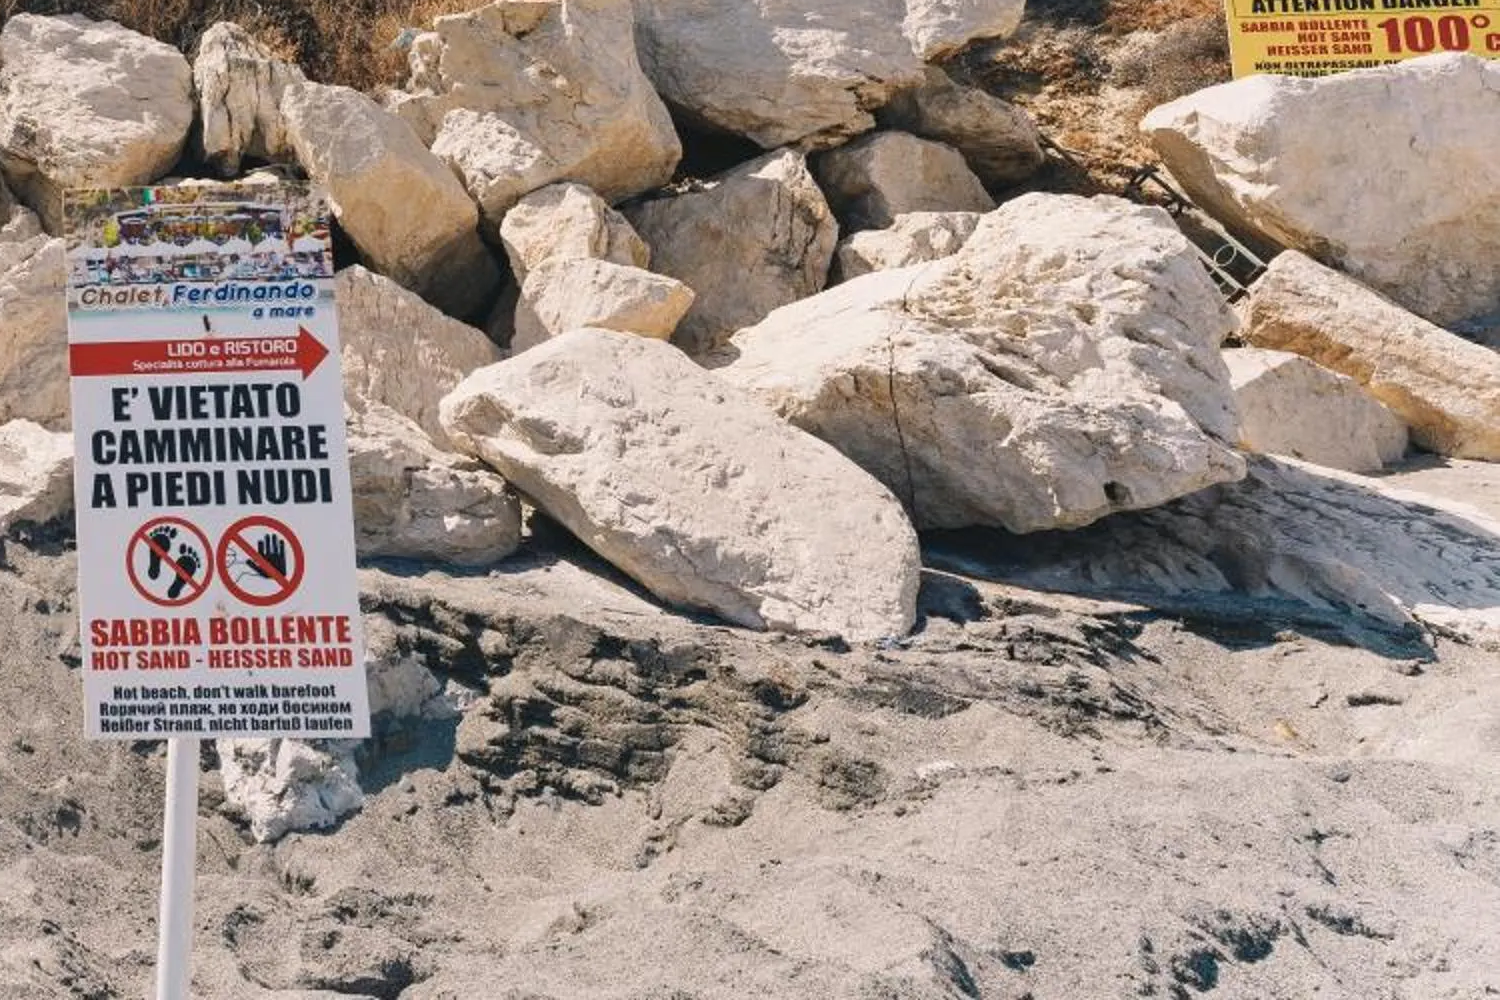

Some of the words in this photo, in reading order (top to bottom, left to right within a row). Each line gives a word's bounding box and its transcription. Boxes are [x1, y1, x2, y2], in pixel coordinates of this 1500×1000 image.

[1241, 21, 1295, 32] SABBIA
[1299, 20, 1368, 30] BOLLENTE
[1298, 32, 1326, 43] HOT
[1331, 32, 1371, 42] SAND
[1268, 45, 1328, 56] HEISSER
[1332, 44, 1372, 54] SAND
[173, 283, 314, 303] Ferdinando
[253, 308, 263, 318] a
[270, 306, 314, 318] mare
[168, 343, 205, 356] LIDO
[210, 344, 220, 355] e
[225, 340, 296, 354] RISTORO
[112, 387, 139, 422] E'
[148, 382, 300, 420] VIETATO
[92, 425, 328, 465] CAMMINARE
[92, 474, 116, 508] A
[126, 470, 225, 507] PIEDI
[237, 468, 333, 505] NUDI
[90, 618, 202, 647] SABBIA
[209, 615, 352, 645] BOLLENTE
[92, 650, 130, 670] HOT
[136, 650, 190, 670] SAND
[208, 649, 292, 668] HEISSER
[298, 648, 352, 667] SAND
[113, 686, 137, 700] Hot
[193, 685, 230, 699] don't
[234, 685, 269, 698] walk
[272, 684, 336, 698] barefoot
[209, 717, 248, 731] nicht
[305, 715, 352, 731] laufen
